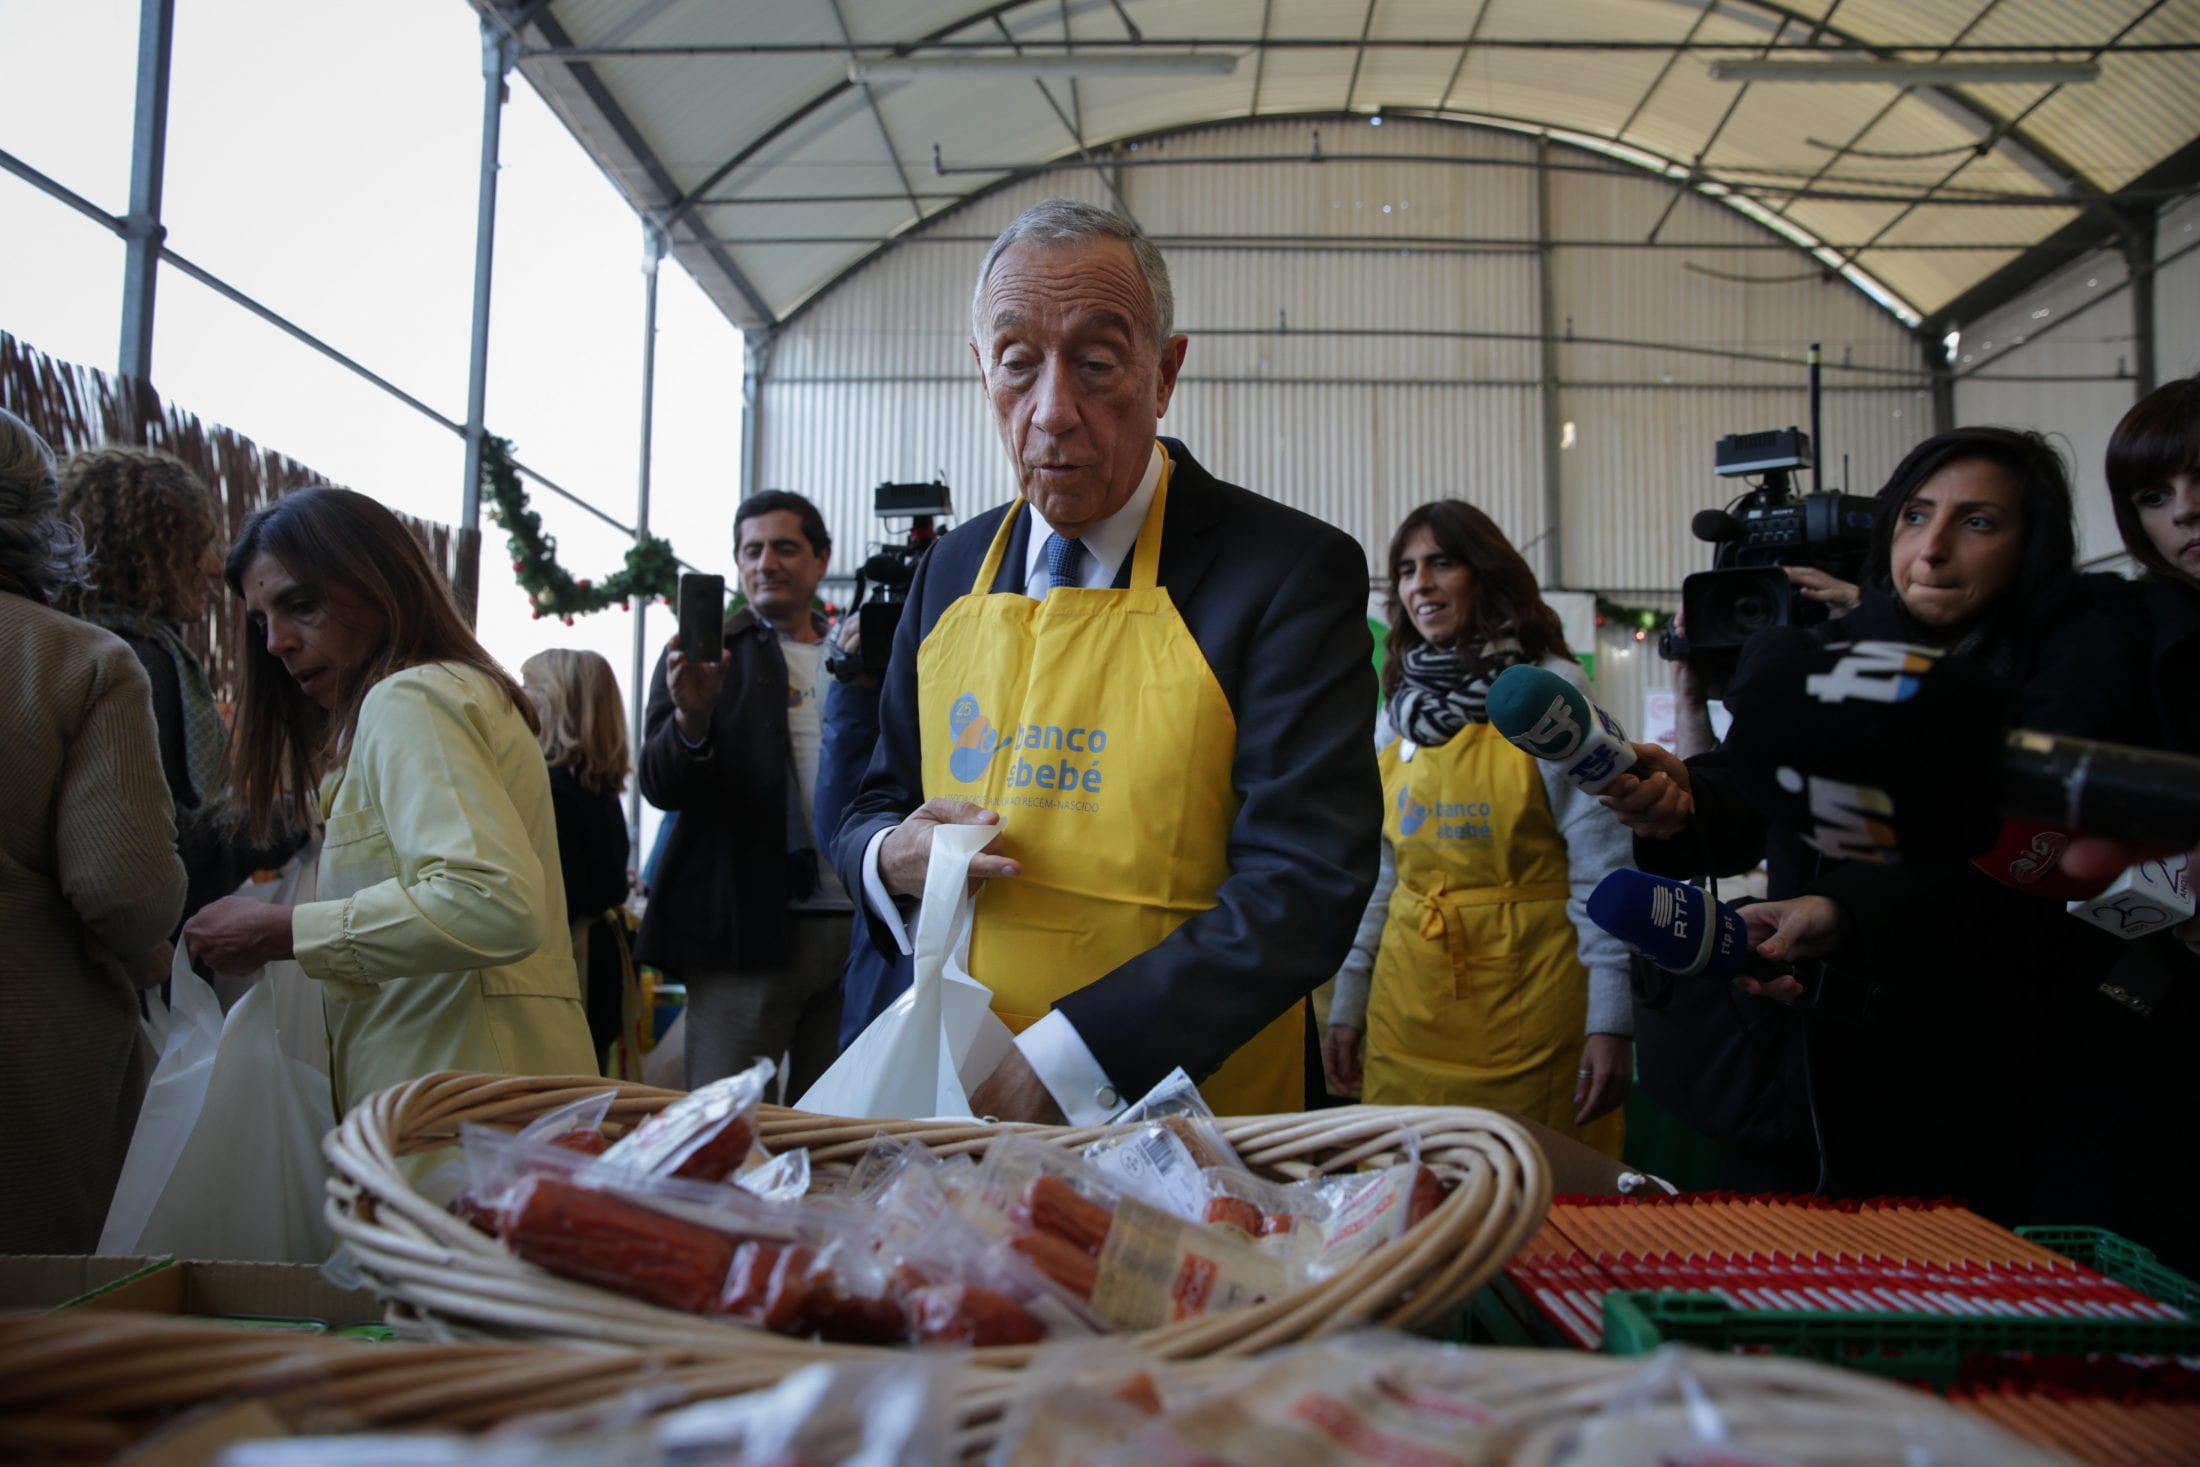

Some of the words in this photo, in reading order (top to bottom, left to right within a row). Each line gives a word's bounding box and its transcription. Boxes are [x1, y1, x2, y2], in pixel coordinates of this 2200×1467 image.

[956, 701, 972, 717] 25
[1016, 757, 1103, 793] bebé
[1673, 886, 1688, 939] RTP
